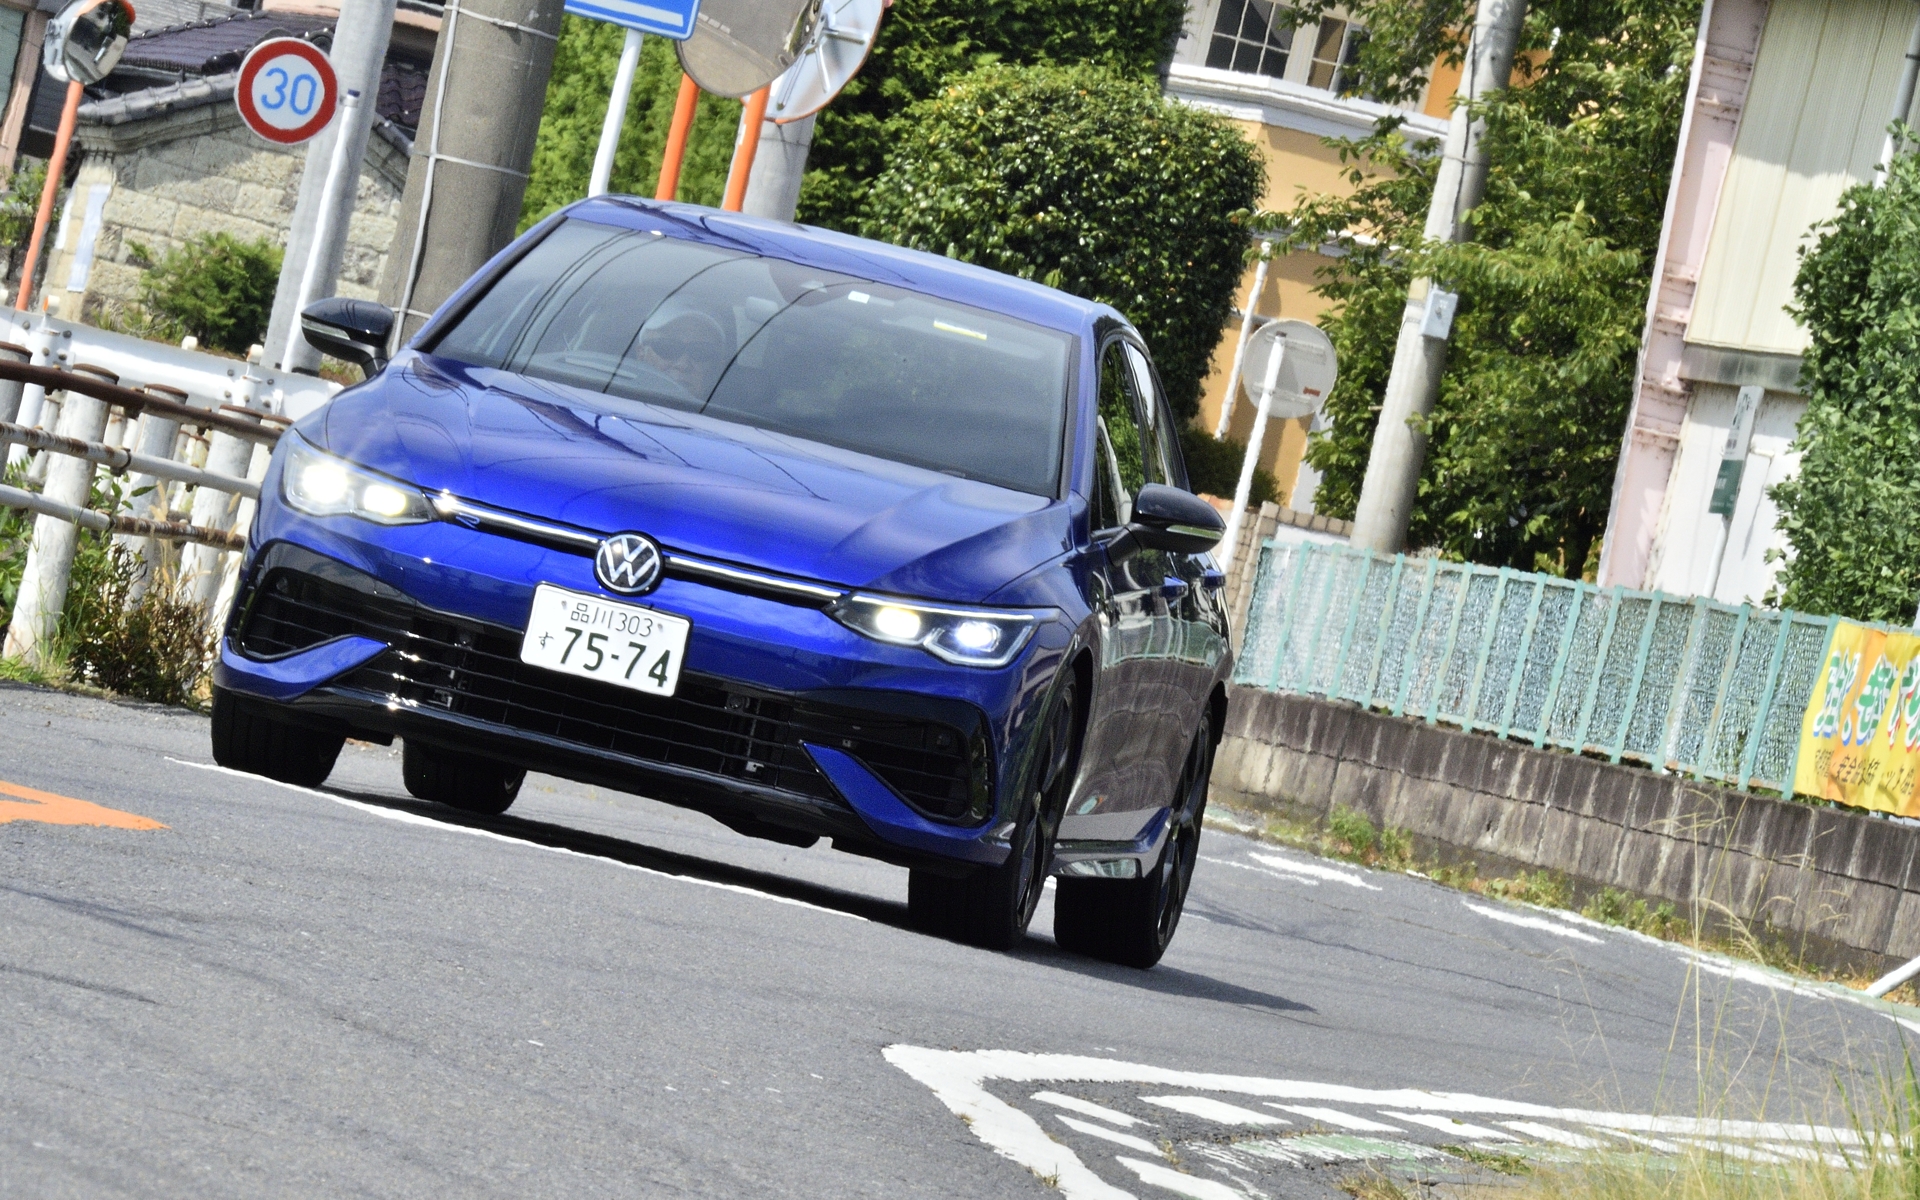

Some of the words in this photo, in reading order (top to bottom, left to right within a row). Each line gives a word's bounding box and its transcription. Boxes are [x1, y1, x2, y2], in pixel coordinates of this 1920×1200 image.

[261, 67, 317, 116] 30
[598, 534, 661, 591] VW
[538, 631, 554, 650] す
[560, 626, 671, 688] 75-74
